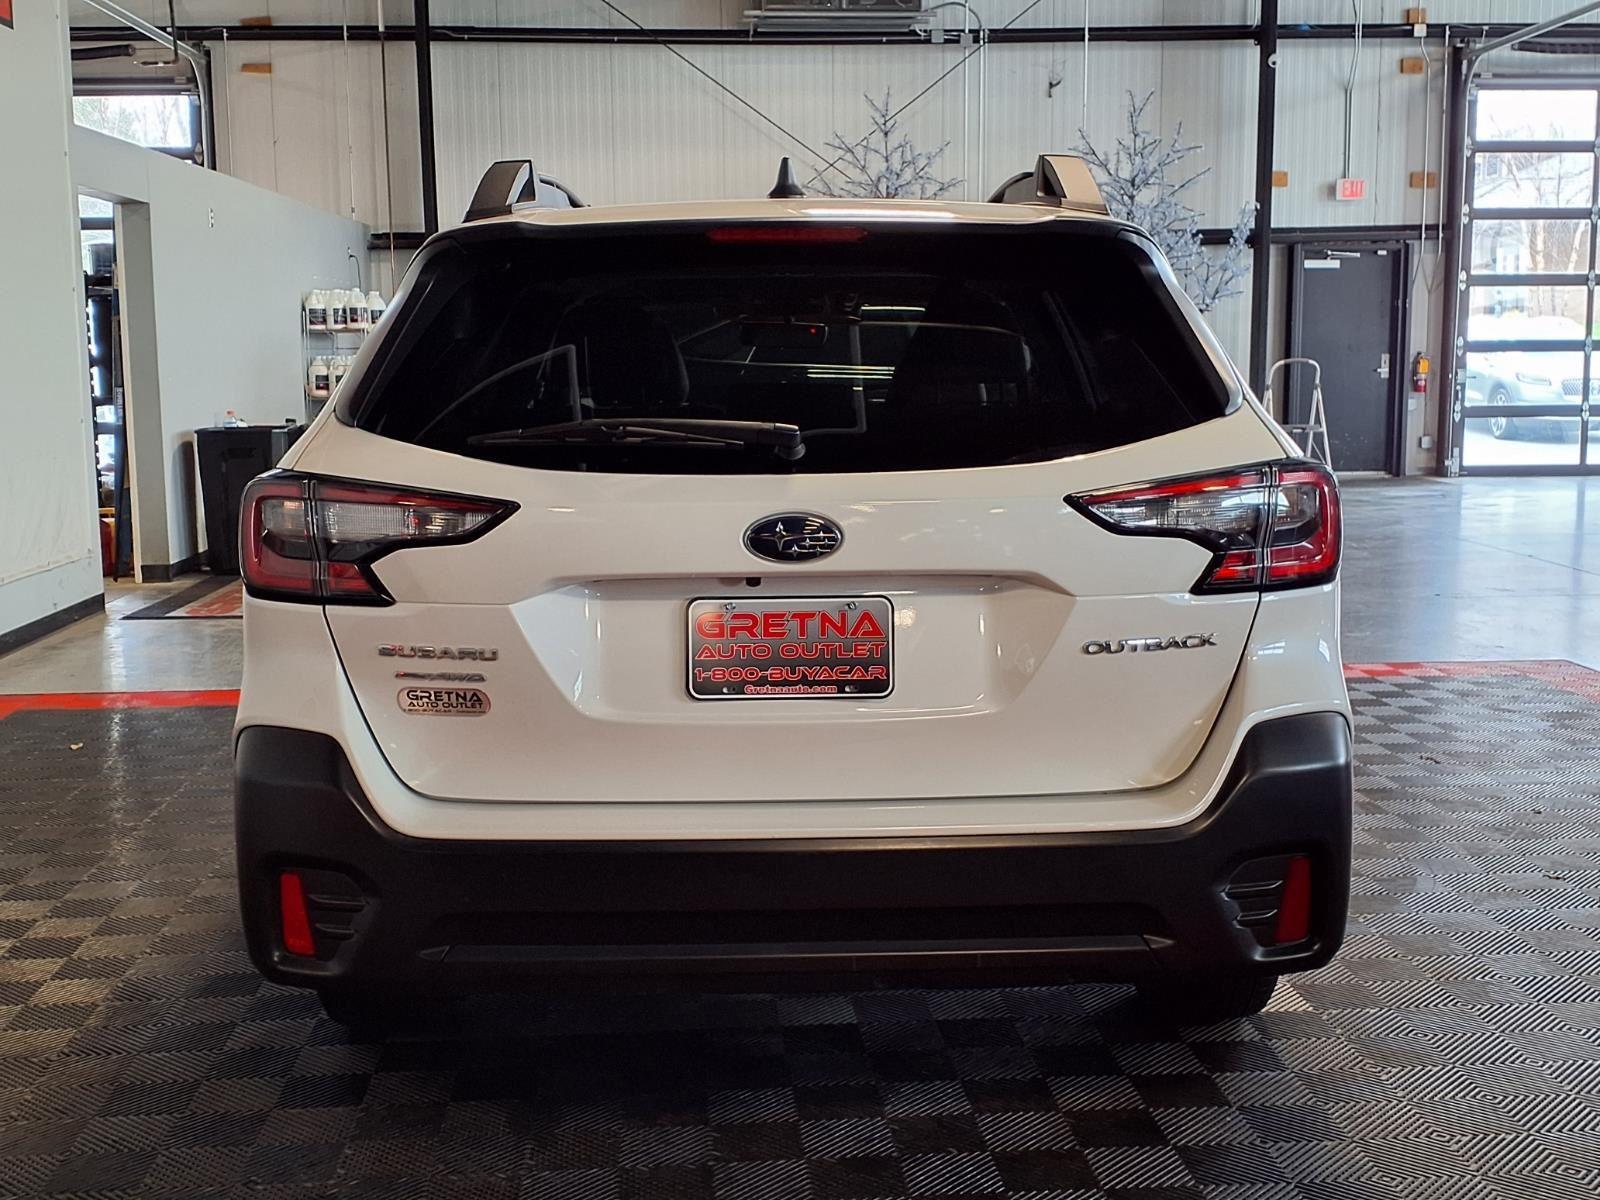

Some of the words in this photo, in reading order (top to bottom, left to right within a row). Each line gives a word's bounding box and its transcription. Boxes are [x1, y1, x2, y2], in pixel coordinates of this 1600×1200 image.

[695, 610, 886, 640] GRETNA
[378, 643, 499, 661] SUBARU
[695, 643, 772, 660] AUTO
[779, 641, 887, 659] OUTLET
[1082, 632, 1217, 655] OUTBACK
[694, 665, 887, 682] 1-800-BUYACAR
[406, 689, 484, 703] GRETNA
[744, 684, 838, 694] Gretnaauto.com
